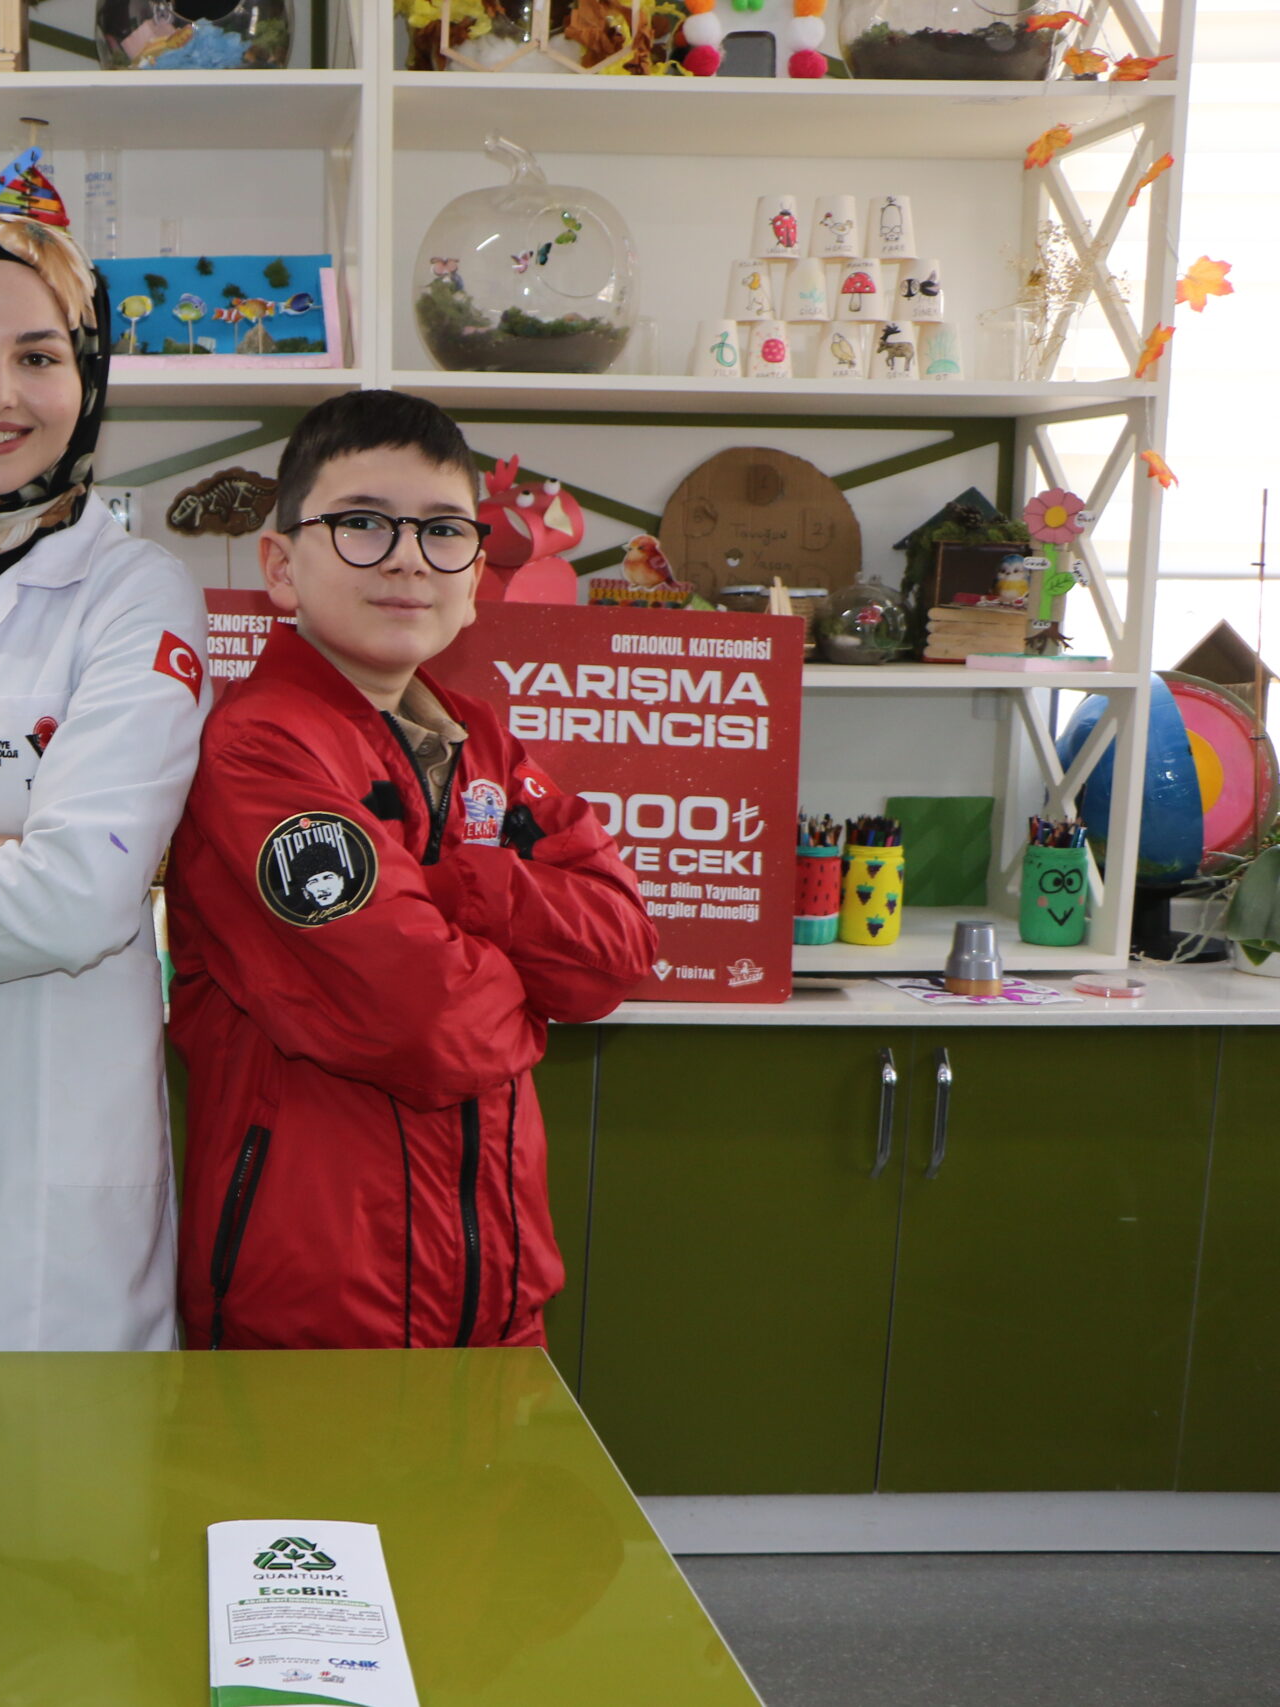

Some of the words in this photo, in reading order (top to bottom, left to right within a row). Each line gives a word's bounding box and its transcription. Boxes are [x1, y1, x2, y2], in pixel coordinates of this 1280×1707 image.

[207, 613, 274, 633] EKNOFEST
[207, 636, 249, 655] OSYAL
[611, 634, 685, 656] ORTAOKUL
[688, 637, 772, 660] KATEGORİSİ
[493, 660, 769, 707] YARIŞMA
[273, 821, 355, 896] ATATÜRK
[668, 847, 762, 876] ÇEKİ
[670, 881, 702, 899] Bilim
[705, 883, 760, 902] Yayınları
[646, 901, 697, 919] Dergiler
[700, 903, 760, 922] Aboneliği
[676, 965, 716, 980] TÜBİTAK
[253, 1573, 345, 1582] QUANTUMX
[258, 1586, 349, 1598] EcoBin:
